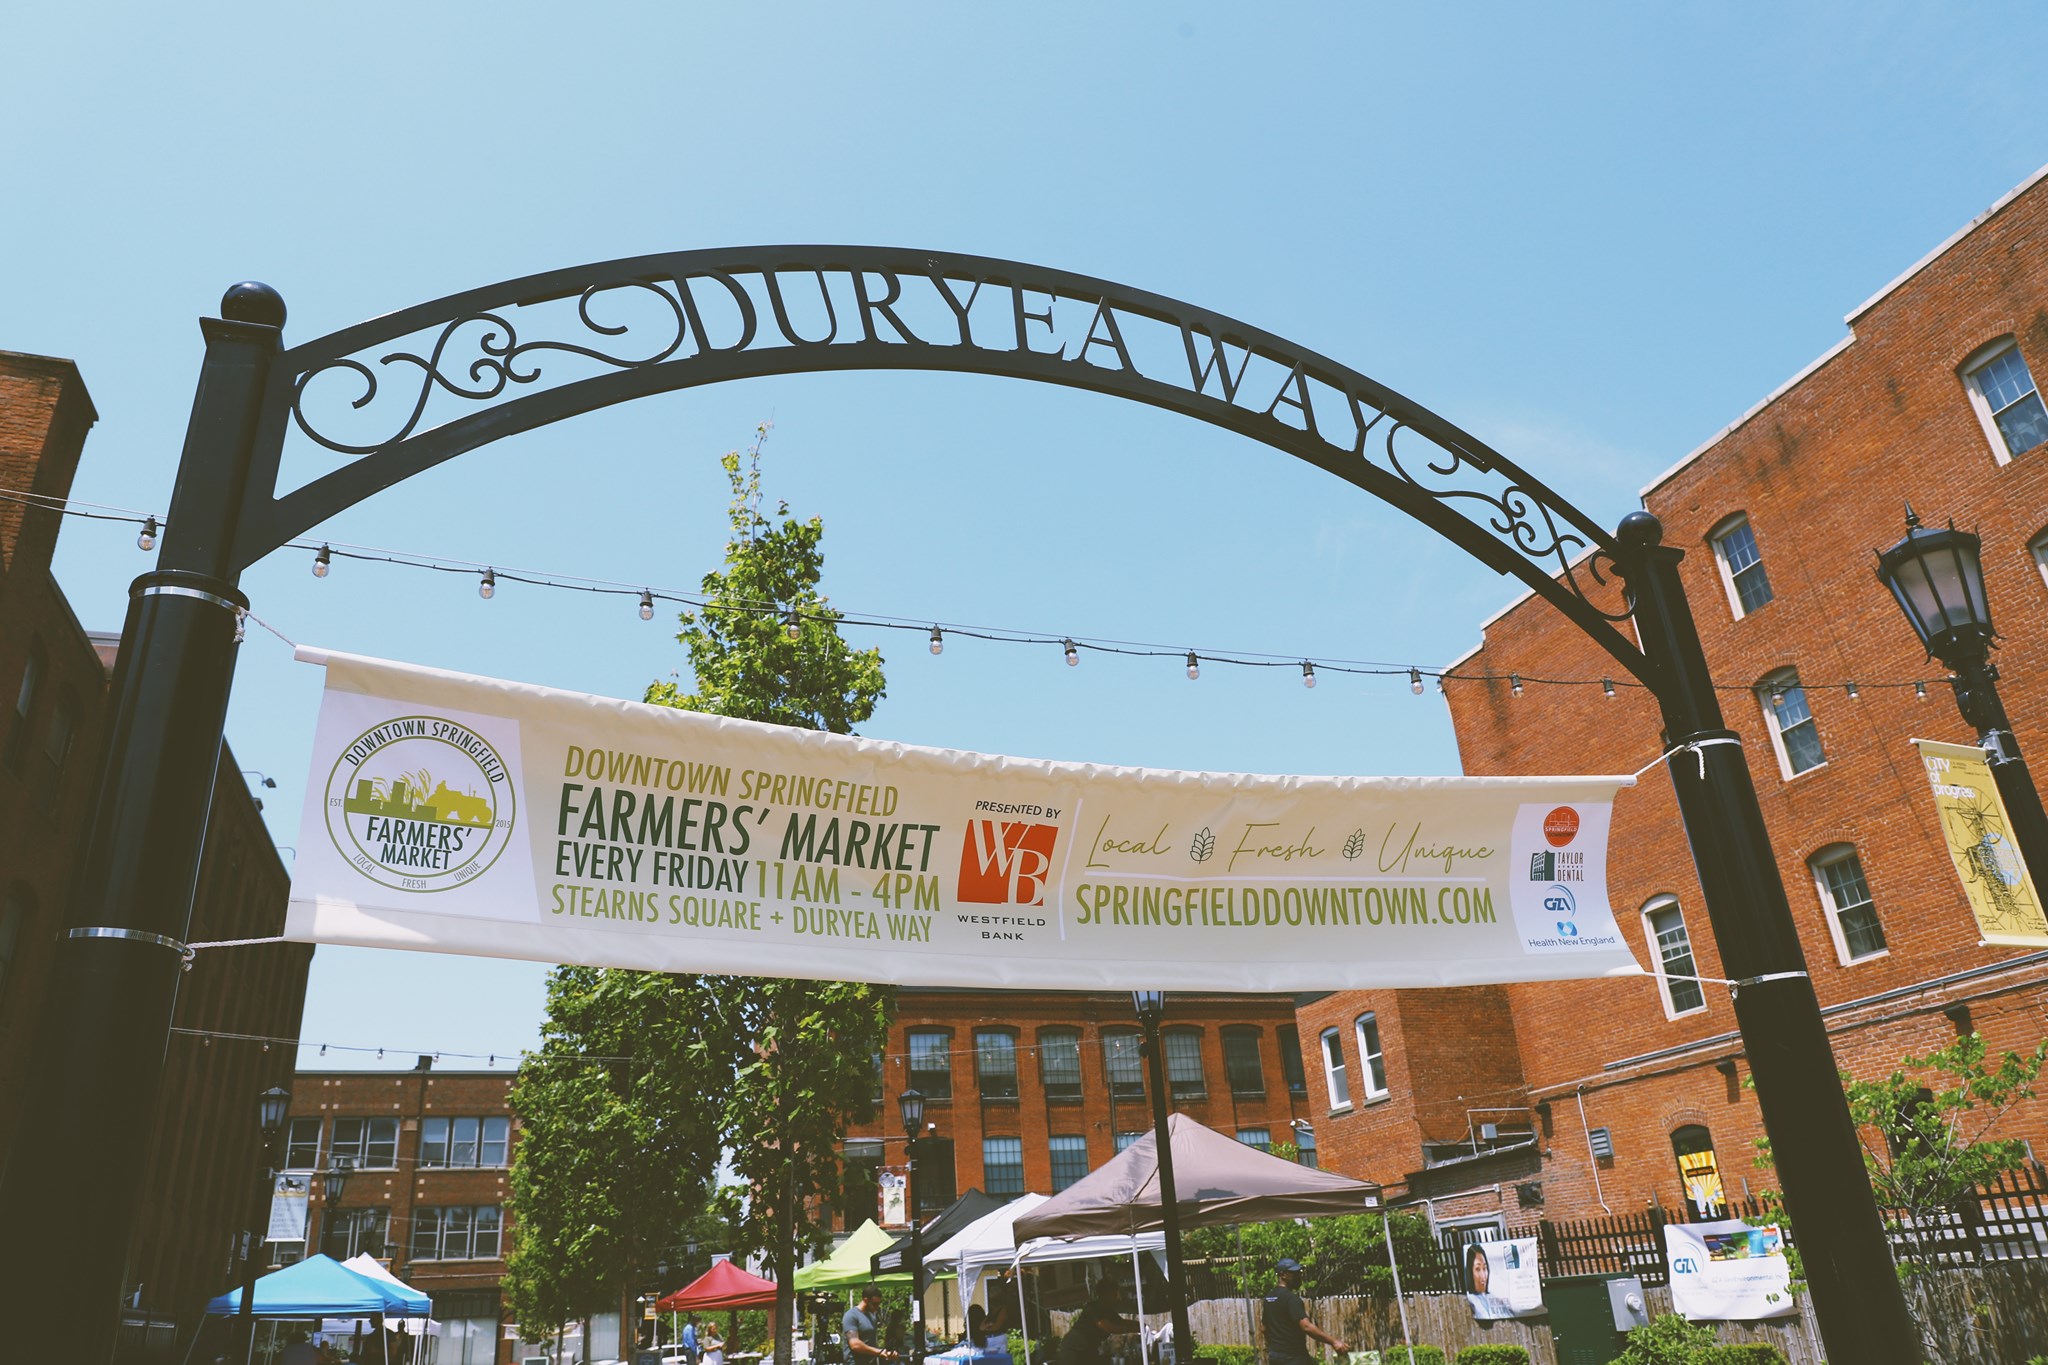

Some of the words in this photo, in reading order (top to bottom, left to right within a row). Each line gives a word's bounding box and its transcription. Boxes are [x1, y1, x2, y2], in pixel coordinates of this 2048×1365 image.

[674, 264, 1143, 378] DURYEA
[1176, 316, 1387, 464] WAY
[345, 720, 426, 766] DOWNTOWN
[432, 722, 505, 783] SPRINGFIELD
[564, 745, 731, 797] DOWNTOWN
[738, 769, 898, 817] SPRINGFIELD
[330, 797, 343, 808] EST.
[975, 800, 1042, 816] PRESENTED
[1046, 807, 1061, 819] BY
[495, 818, 511, 829] 2015
[780, 813, 941, 872] MARKET
[1086, 814, 1171, 868] Local
[1228, 822, 1325, 872] Fresh
[1378, 822, 1495, 874] Unique
[353, 853, 376, 874] LOCAL
[380, 843, 452, 870] MARKET
[1558, 852, 1583, 864] TAYLOR
[453, 860, 482, 882] UNIQUE
[555, 840, 643, 882] EVERY
[653, 851, 749, 894] FRIDAY
[756, 860, 840, 904] 11AM
[872, 872, 941, 911] 4PM
[1558, 869, 1584, 881] DENTAL
[402, 878, 427, 889] FRESH
[551, 883, 659, 923] STEARNS
[668, 895, 761, 931] SQUARE
[793, 906, 881, 940] DURYEA
[887, 913, 932, 943] WAY
[1076, 883, 1497, 926] SPRINGFIELDDOWNTOWN.COM
[957, 915, 1046, 927] WESTFIELD
[981, 931, 1024, 941] BANK
[1528, 938, 1557, 947] Health
[1558, 937, 1578, 946] New
[1579, 936, 1615, 946] England
